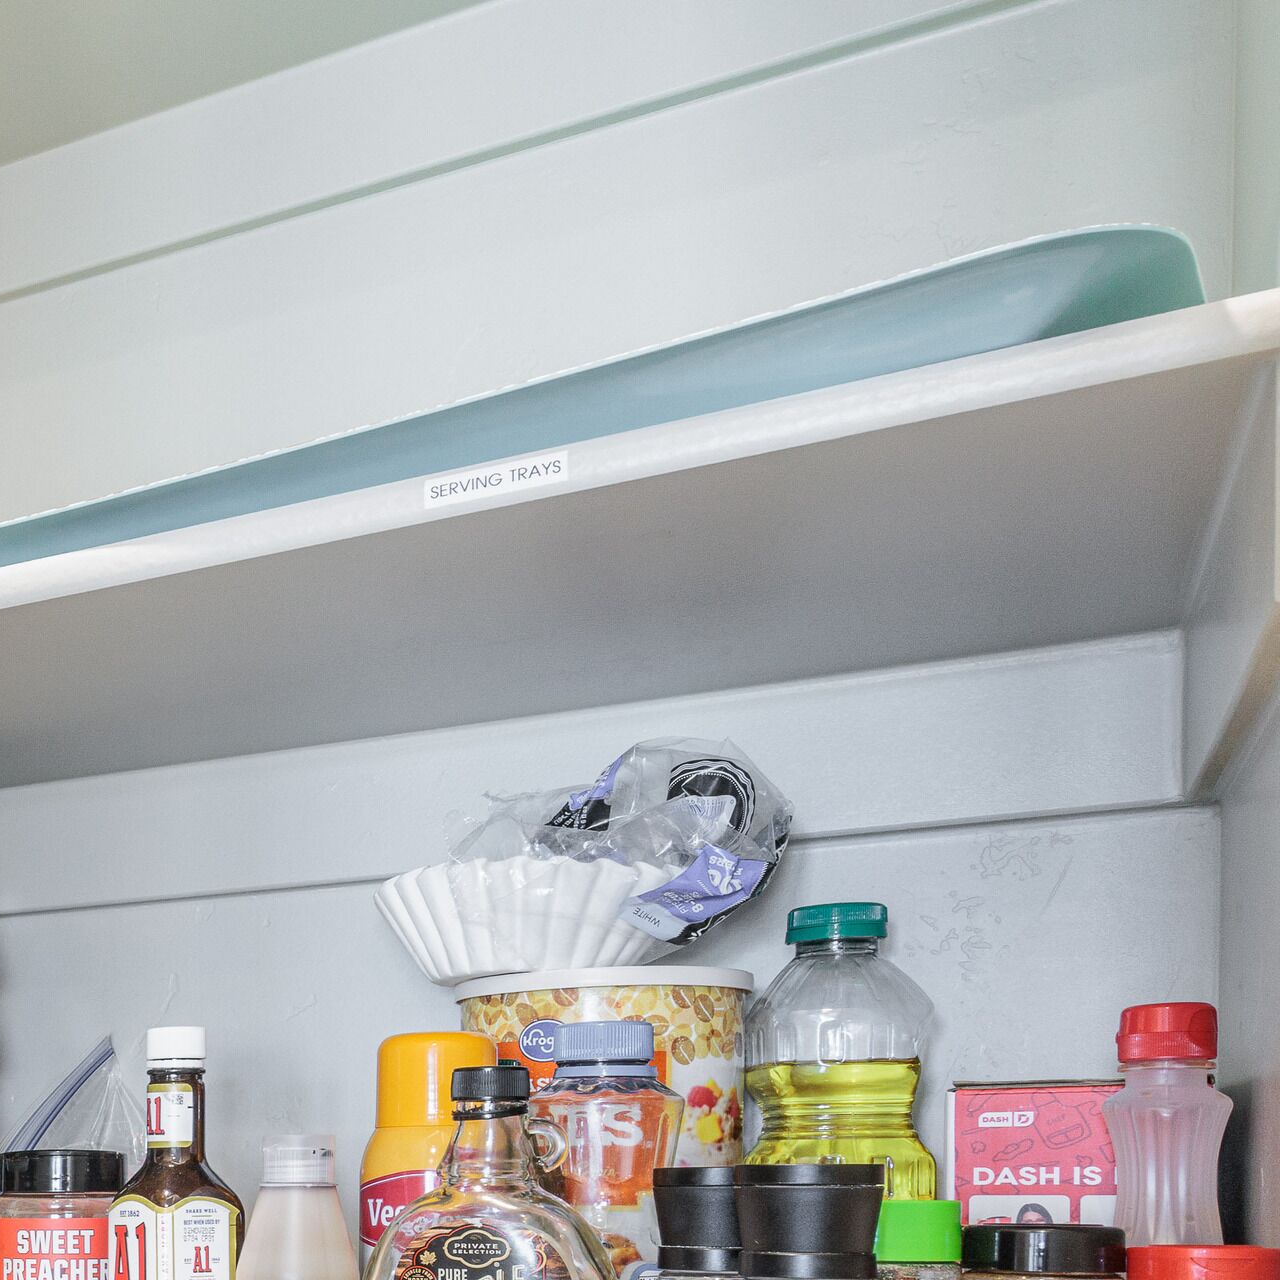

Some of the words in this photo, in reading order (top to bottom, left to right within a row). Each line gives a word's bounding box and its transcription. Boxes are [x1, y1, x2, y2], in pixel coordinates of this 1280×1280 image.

[430, 473, 503, 499] SERVING
[510, 460, 561, 482] TRAYS
[973, 1166, 1061, 1186] DASH
[1073, 1166, 1102, 1186] IS
[16, 1229, 95, 1255] SWEET
